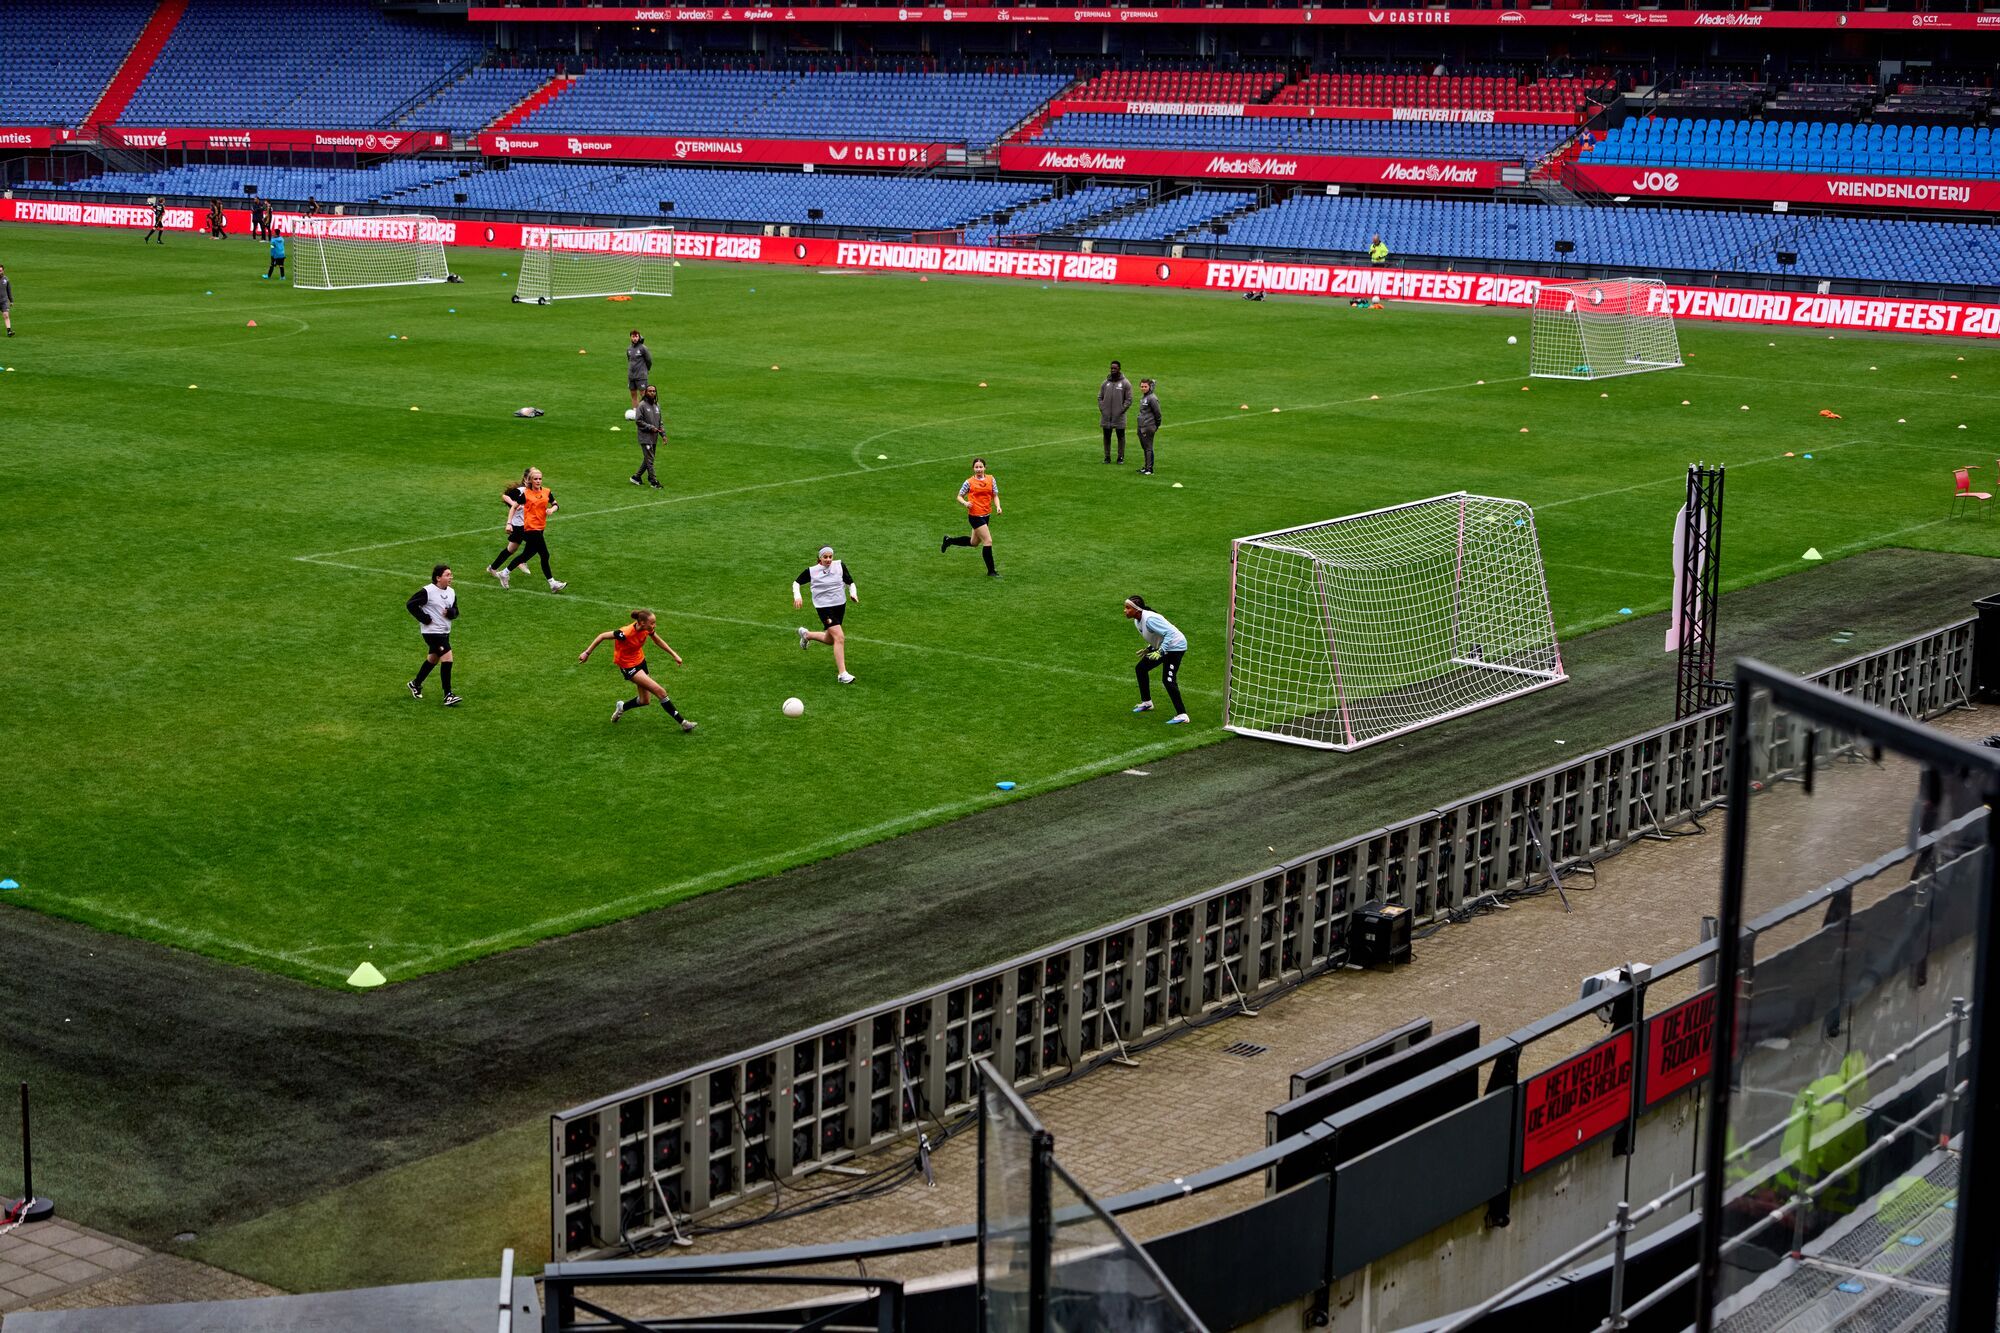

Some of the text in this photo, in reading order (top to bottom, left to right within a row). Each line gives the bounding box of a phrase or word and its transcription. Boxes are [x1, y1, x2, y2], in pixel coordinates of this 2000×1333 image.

[635, 10, 664, 20] Jordex
[676, 10, 706, 20] Jordex
[744, 10, 773, 19] Spido
[1390, 12, 1450, 22] CASTORE
[1127, 102, 1244, 116] FEYENOORD ROTTERDAM
[1392, 108, 1494, 122] WHATEVER IT TAKES
[0, 133, 32, 143] nties
[316, 134, 364, 147] Dusseldorp
[582, 142, 612, 150] GROUP
[675, 141, 743, 158] QTERMINALS
[854, 146, 928, 162] CASTORE
[1827, 181, 1970, 203] VRIENDENLOTERIJ
[15, 202, 82, 222] FEYENOORD
[418, 222, 456, 242] 2026
[715, 237, 761, 259] 2026
[837, 242, 1118, 280] FEYENOORD ZOMERFEEST 2026
[1206, 262, 1541, 304] FEYENOORD ZOMERFEEST 2026
[1646, 288, 2000, 334] FEYENOORD ZOMERFEEST 20
[1660, 1024, 1713, 1076] ROOKV
[1546, 1044, 1616, 1101] HET VELD IN
[1528, 1103, 1546, 1134] DE
[1546, 1088, 1578, 1125] KUIP
[1578, 1080, 1592, 1108] IS
[1592, 1060, 1631, 1100] HEILIG
